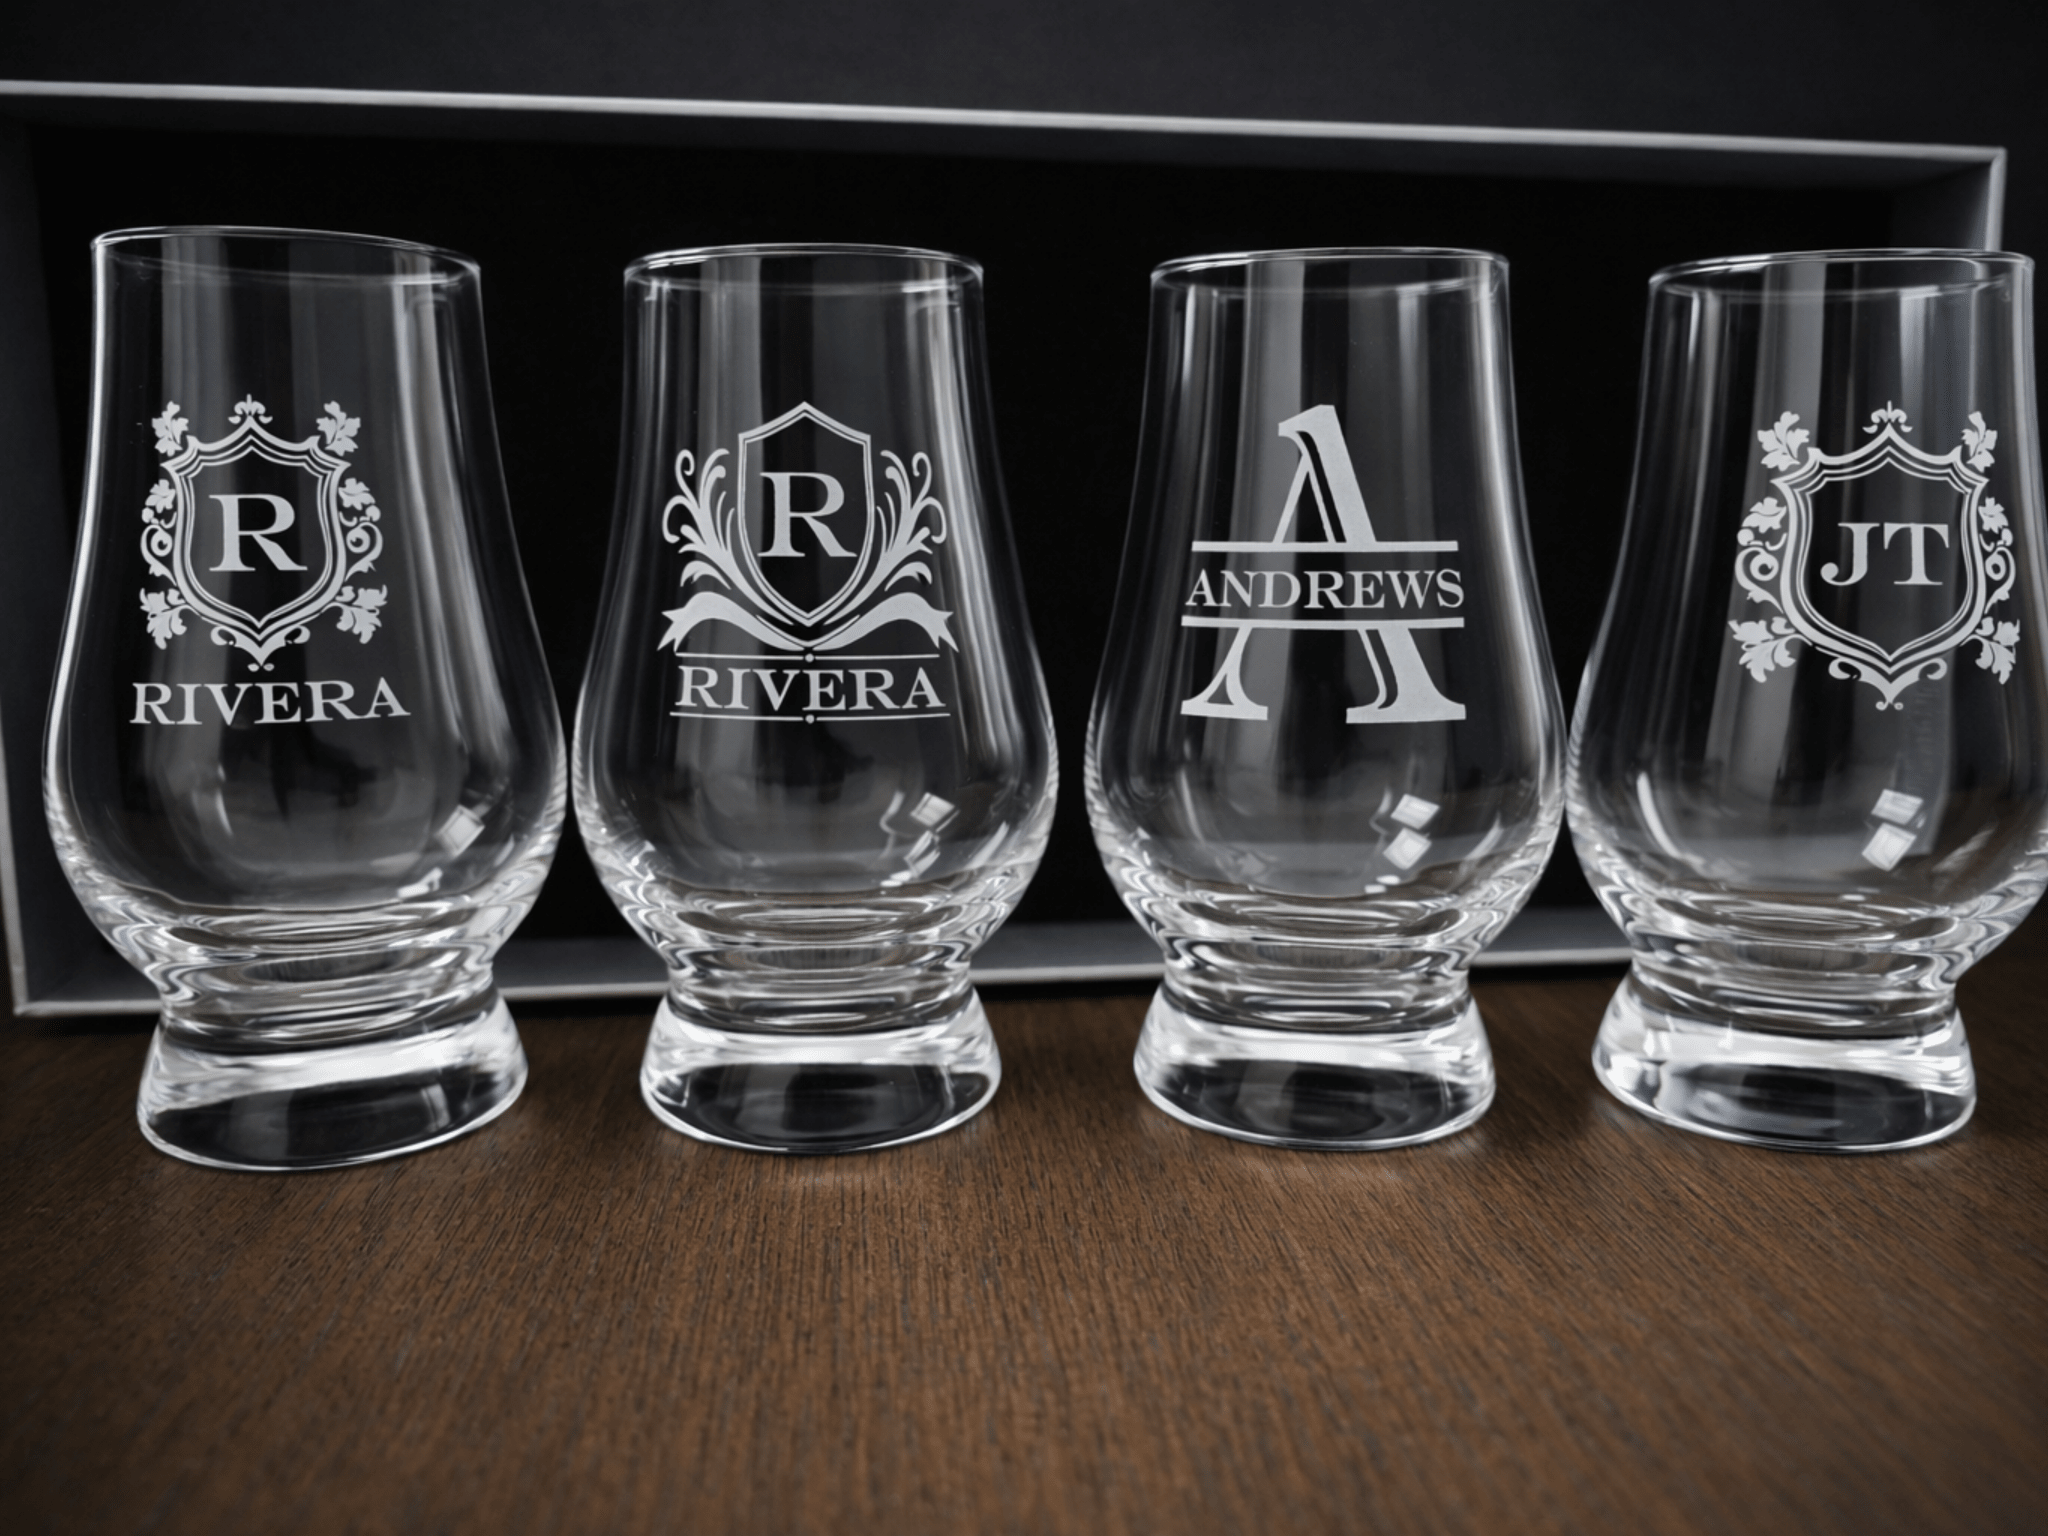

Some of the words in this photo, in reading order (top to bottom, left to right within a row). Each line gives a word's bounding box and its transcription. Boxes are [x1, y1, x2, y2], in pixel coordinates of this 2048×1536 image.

[208, 493, 309, 573] R
[757, 472, 857, 558] R
[1181, 404, 1467, 724] A
[1820, 521, 1951, 587] JT
[1184, 568, 1465, 610] ANDREWS
[129, 676, 411, 726] RIVERA
[674, 664, 945, 712] RIVERA
